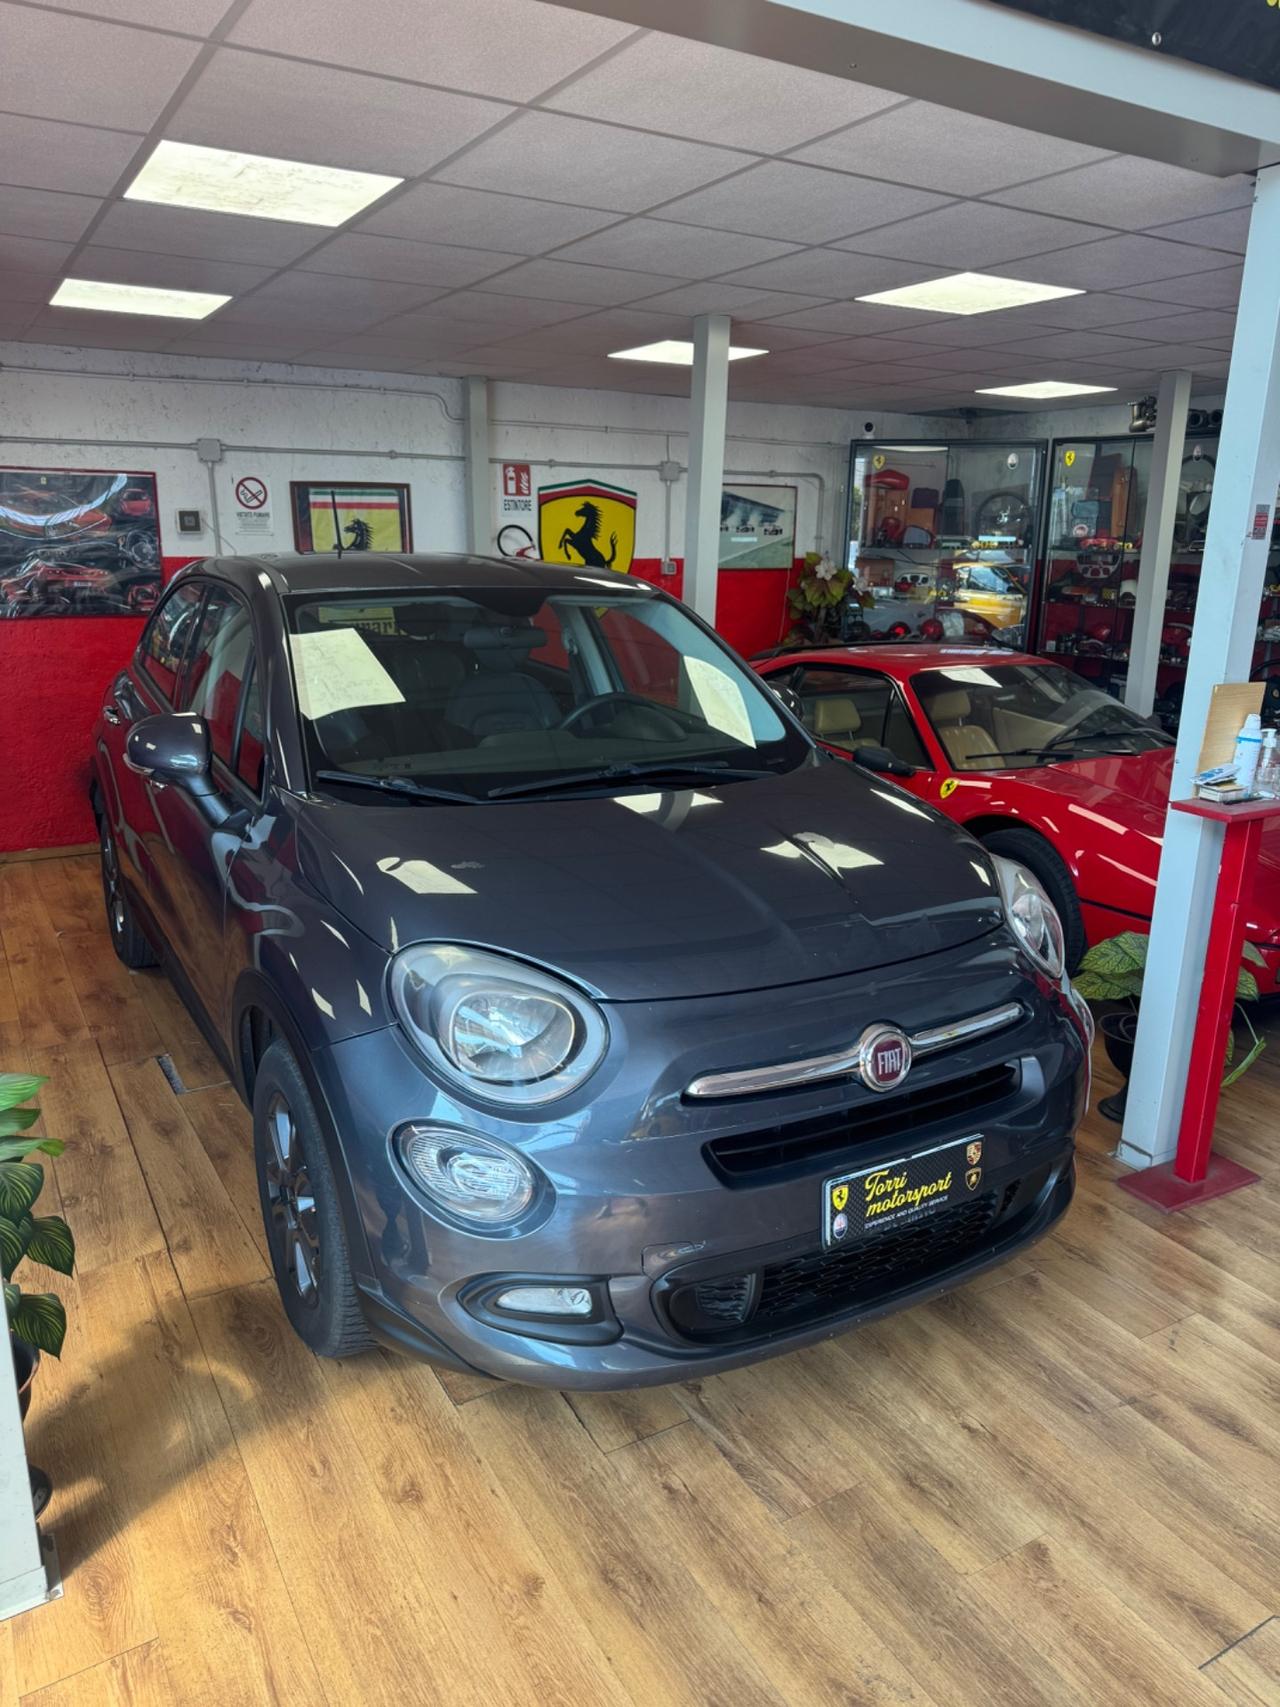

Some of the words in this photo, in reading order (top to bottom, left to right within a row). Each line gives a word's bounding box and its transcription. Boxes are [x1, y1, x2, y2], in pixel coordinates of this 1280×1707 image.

[504, 499, 532, 511] ESTINTORE
[877, 1048, 901, 1075] FIAT
[865, 1169, 907, 1201] Torri
[866, 1171, 952, 1217] motorsport
